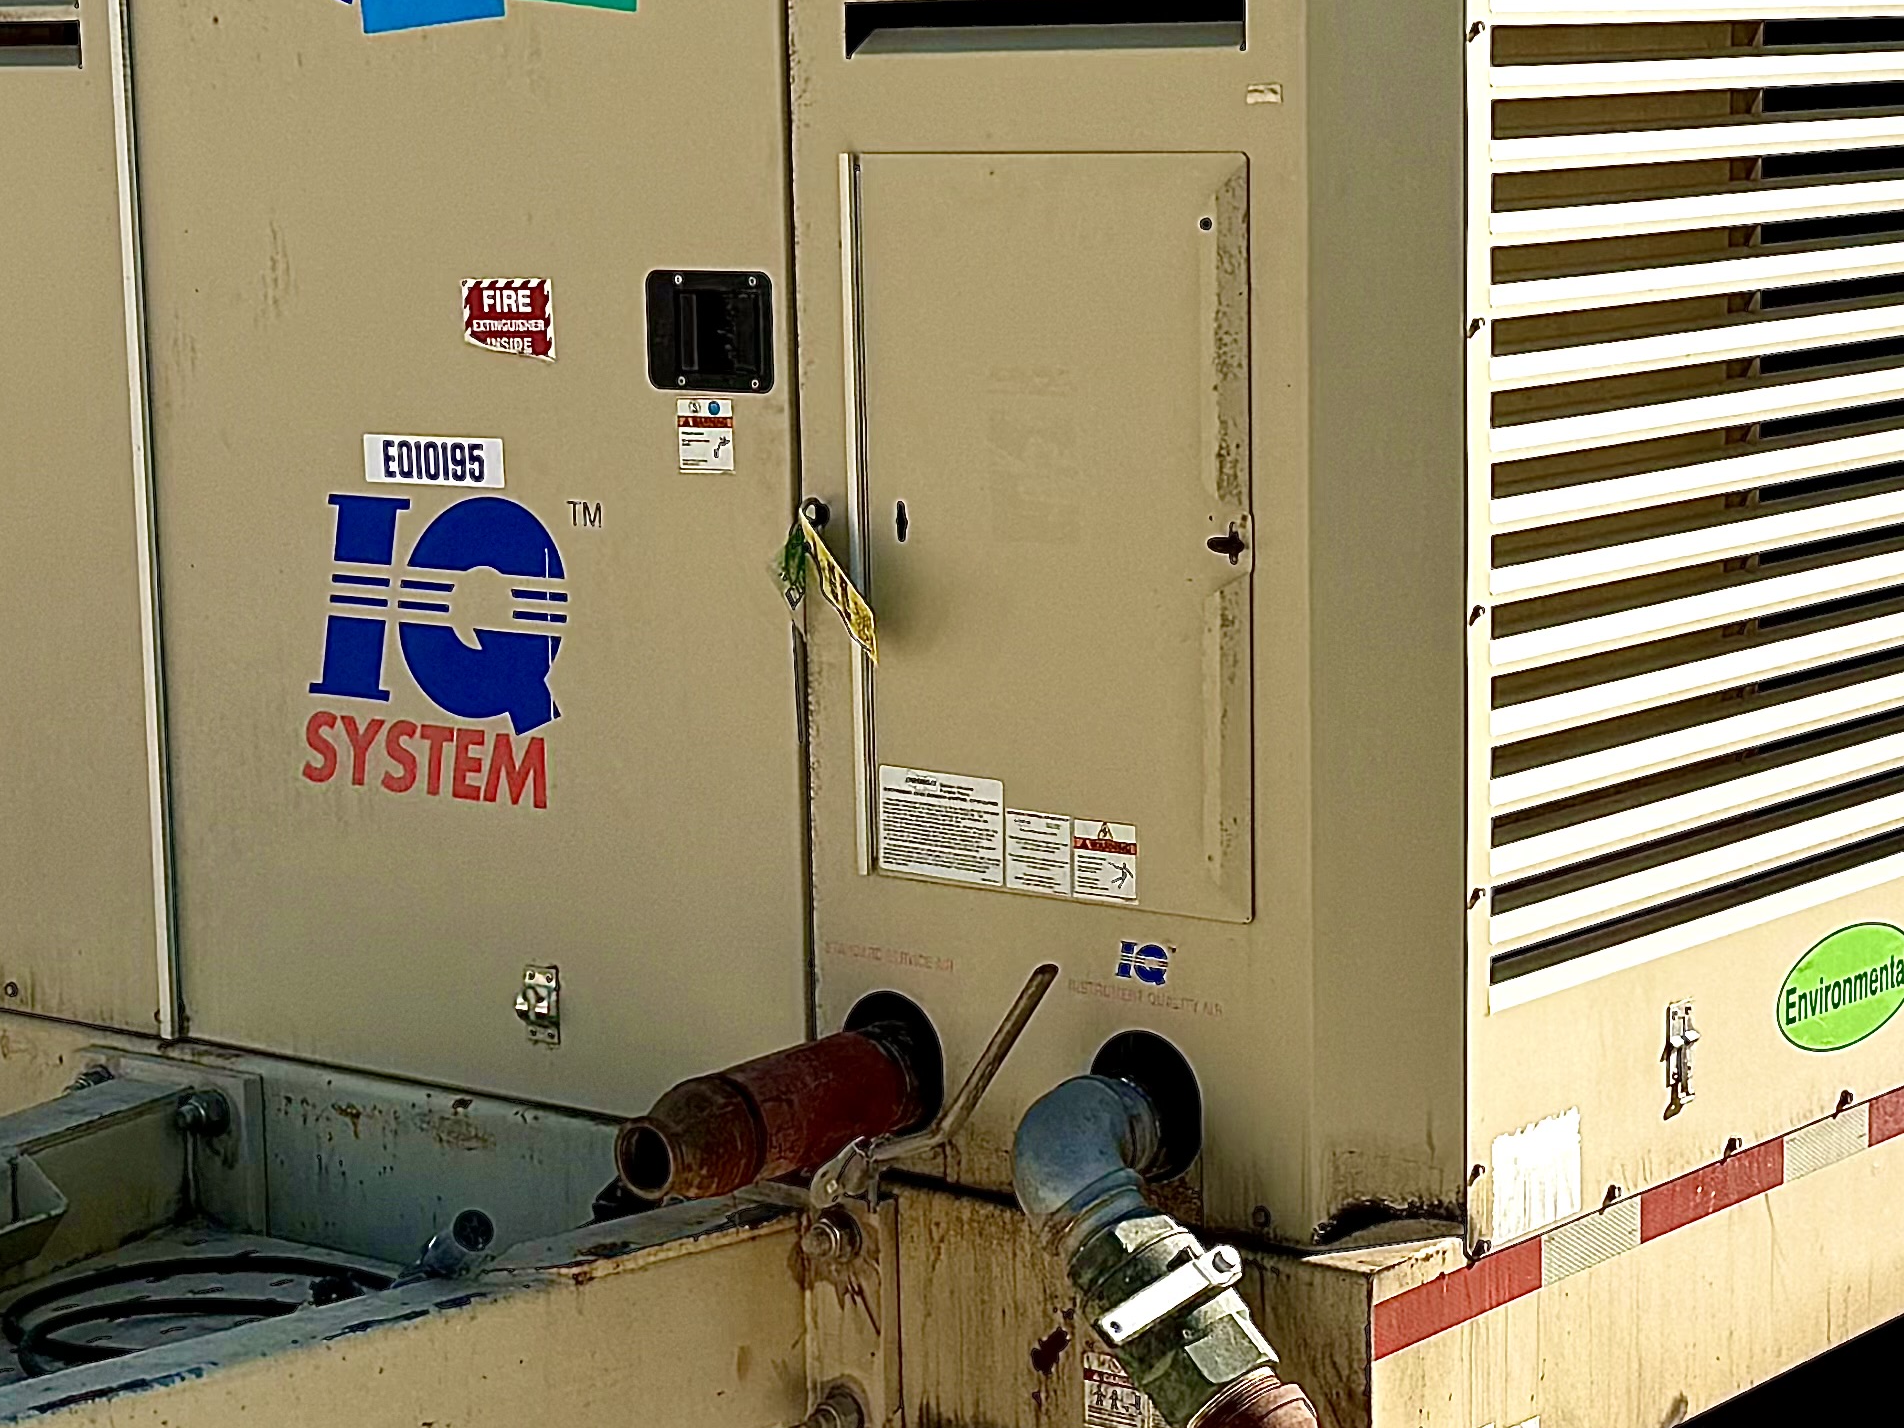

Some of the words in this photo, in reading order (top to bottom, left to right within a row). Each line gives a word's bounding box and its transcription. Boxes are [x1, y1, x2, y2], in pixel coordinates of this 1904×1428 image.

[482, 289, 533, 313] FIRE
[308, 493, 569, 737] IQ
[566, 500, 603, 529] TM
[302, 710, 548, 810] SYSTEM
[1114, 940, 1169, 986] IQ
